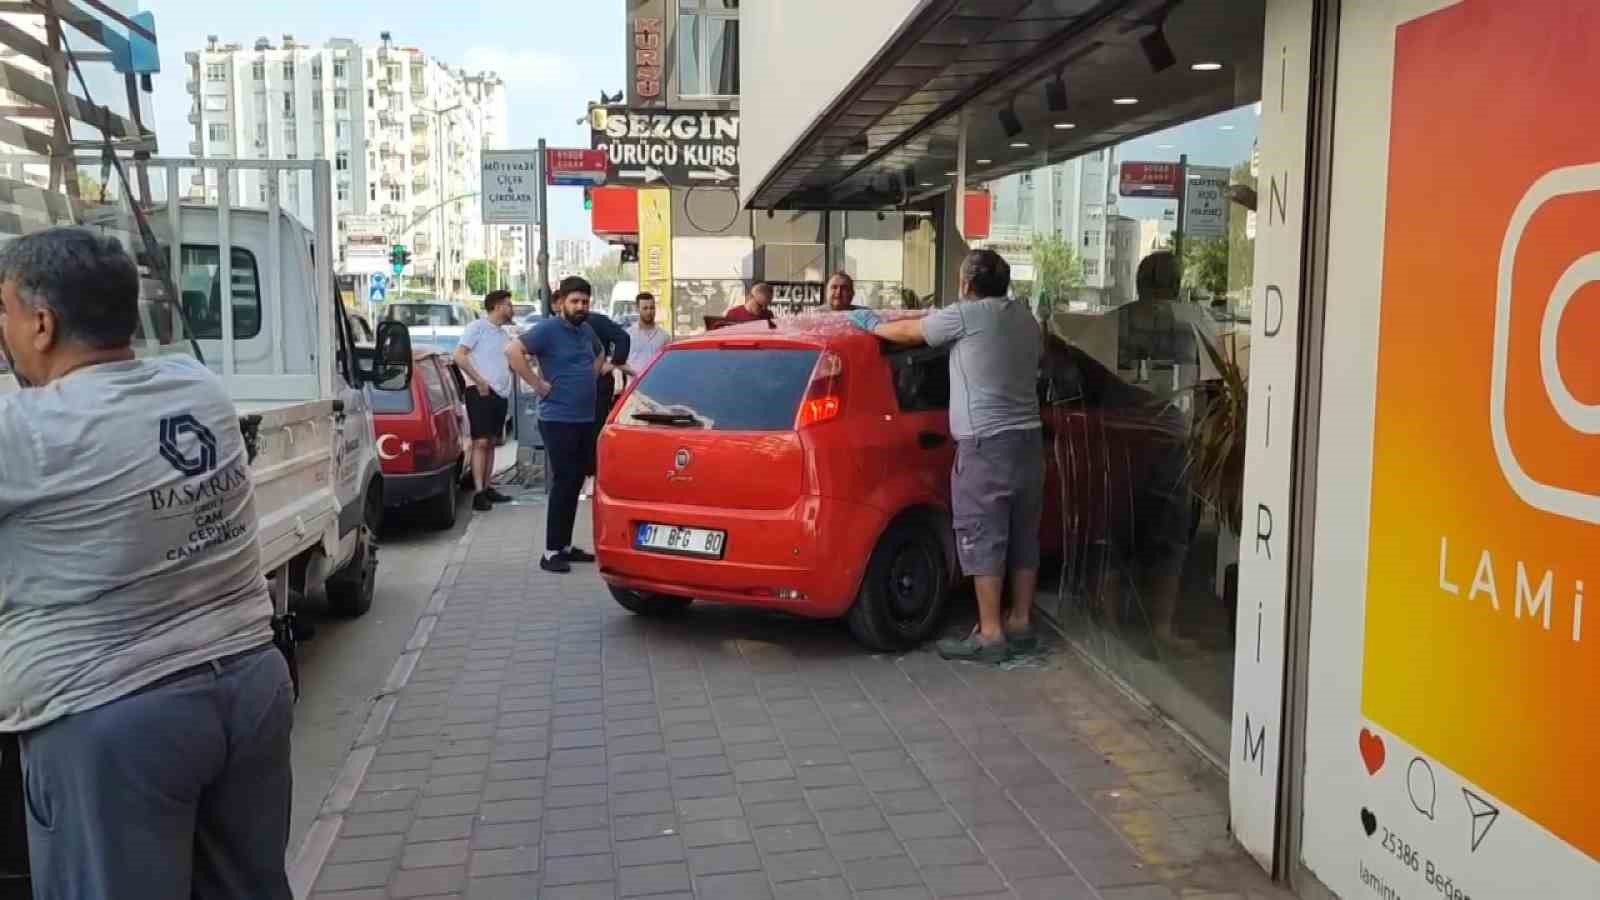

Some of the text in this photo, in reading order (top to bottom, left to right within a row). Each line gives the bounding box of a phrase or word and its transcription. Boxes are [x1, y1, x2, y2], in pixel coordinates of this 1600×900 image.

[606, 111, 740, 140] SEZGİN
[683, 145, 740, 166] KURS
[668, 529, 691, 547] BFG
[705, 533, 722, 551] 80
[1381, 826, 1420, 871] 25386
